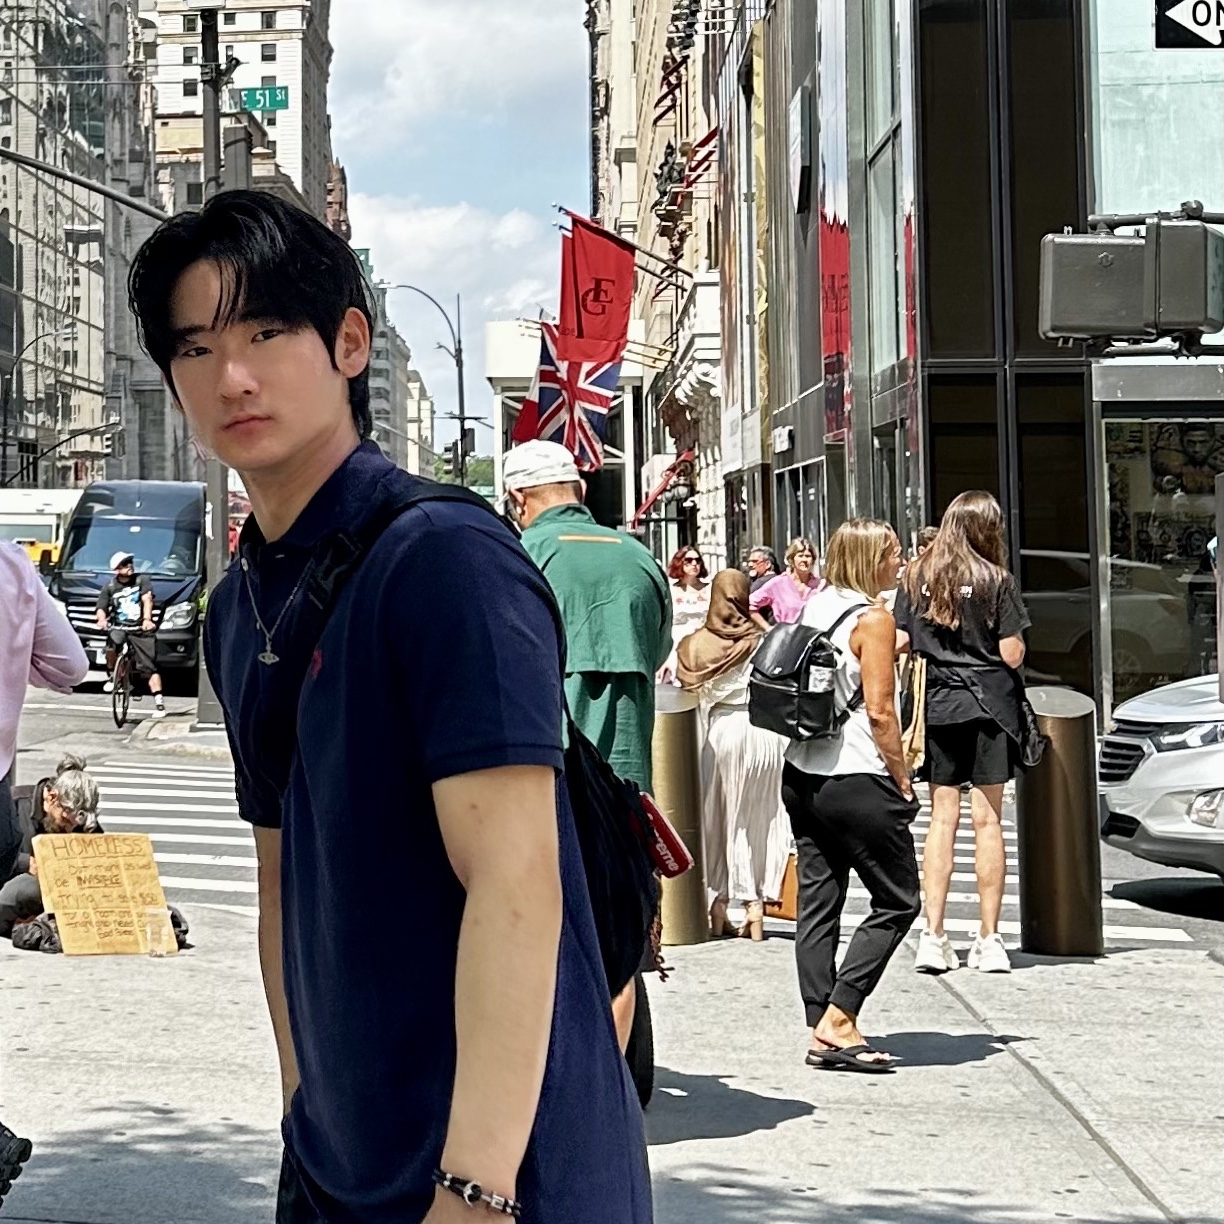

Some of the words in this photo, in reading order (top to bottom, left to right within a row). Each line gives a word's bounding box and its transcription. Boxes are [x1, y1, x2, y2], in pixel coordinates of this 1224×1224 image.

[240, 90, 249, 108] E
[256, 89, 270, 108] 51
[276, 89, 285, 101] St
[51, 837, 144, 857] HOMELESS
